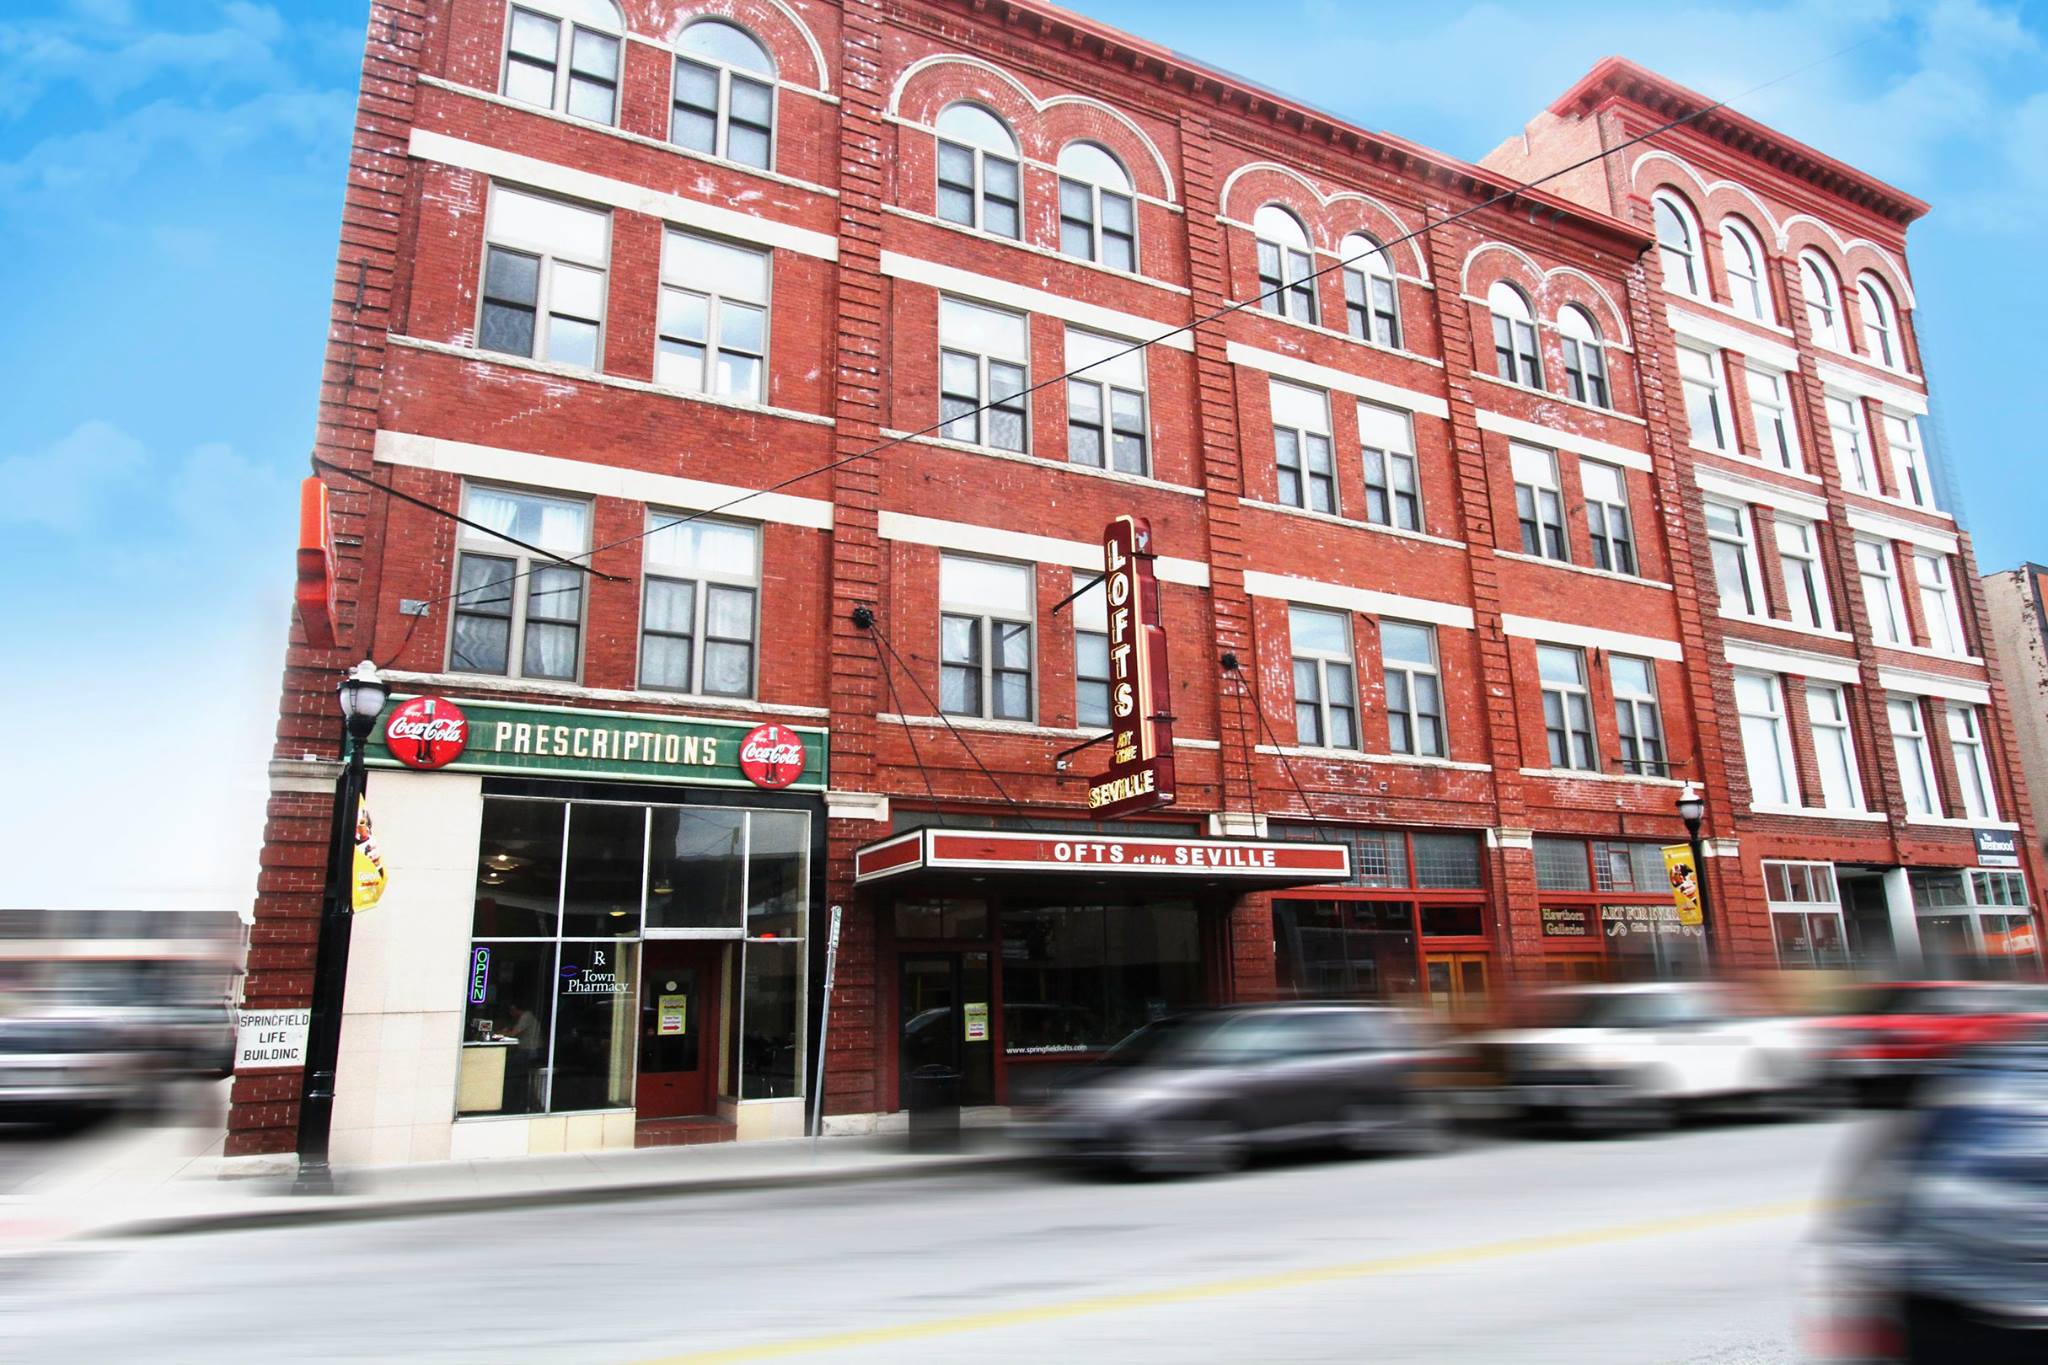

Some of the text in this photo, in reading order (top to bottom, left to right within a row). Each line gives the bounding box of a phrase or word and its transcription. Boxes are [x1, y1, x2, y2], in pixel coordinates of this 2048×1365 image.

[1107, 539, 1133, 718] LOFTS
[495, 721, 717, 766] PRESCRIPTIONS
[1116, 731, 1134, 749] AT
[1115, 745, 1138, 764] THE
[1088, 769, 1155, 809] SEVILLE
[1175, 846, 1276, 867] SEVILLE
[1546, 922, 1585, 935] Galleries
[474, 950, 488, 1000] OPEN
[582, 969, 617, 983] Town
[568, 979, 629, 994] Pharmacy
[240, 1014, 309, 1027] SPRINGFIELD
[259, 1031, 286, 1043] LIFE
[1006, 1044, 1087, 1054] www.springfieldlofts.com
